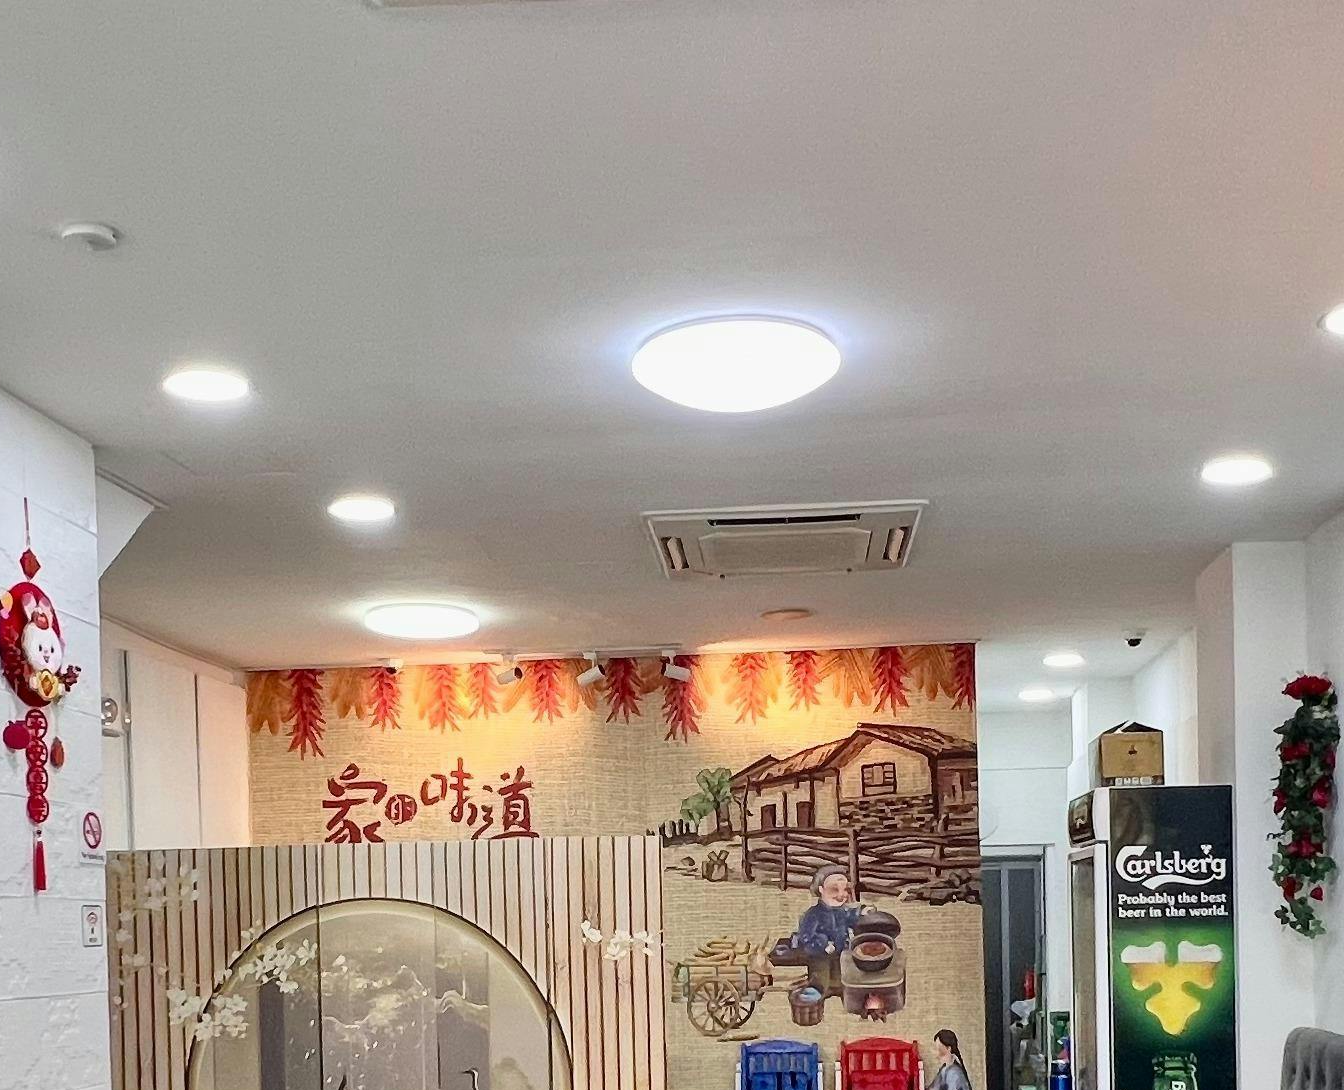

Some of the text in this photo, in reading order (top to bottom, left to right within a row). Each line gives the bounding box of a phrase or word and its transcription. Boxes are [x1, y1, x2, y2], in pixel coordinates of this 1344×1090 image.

[1115, 845, 1227, 890] Carlsberg
[1117, 891, 1227, 906] Probably the best
[1118, 905, 1229, 918] beer in the world.
